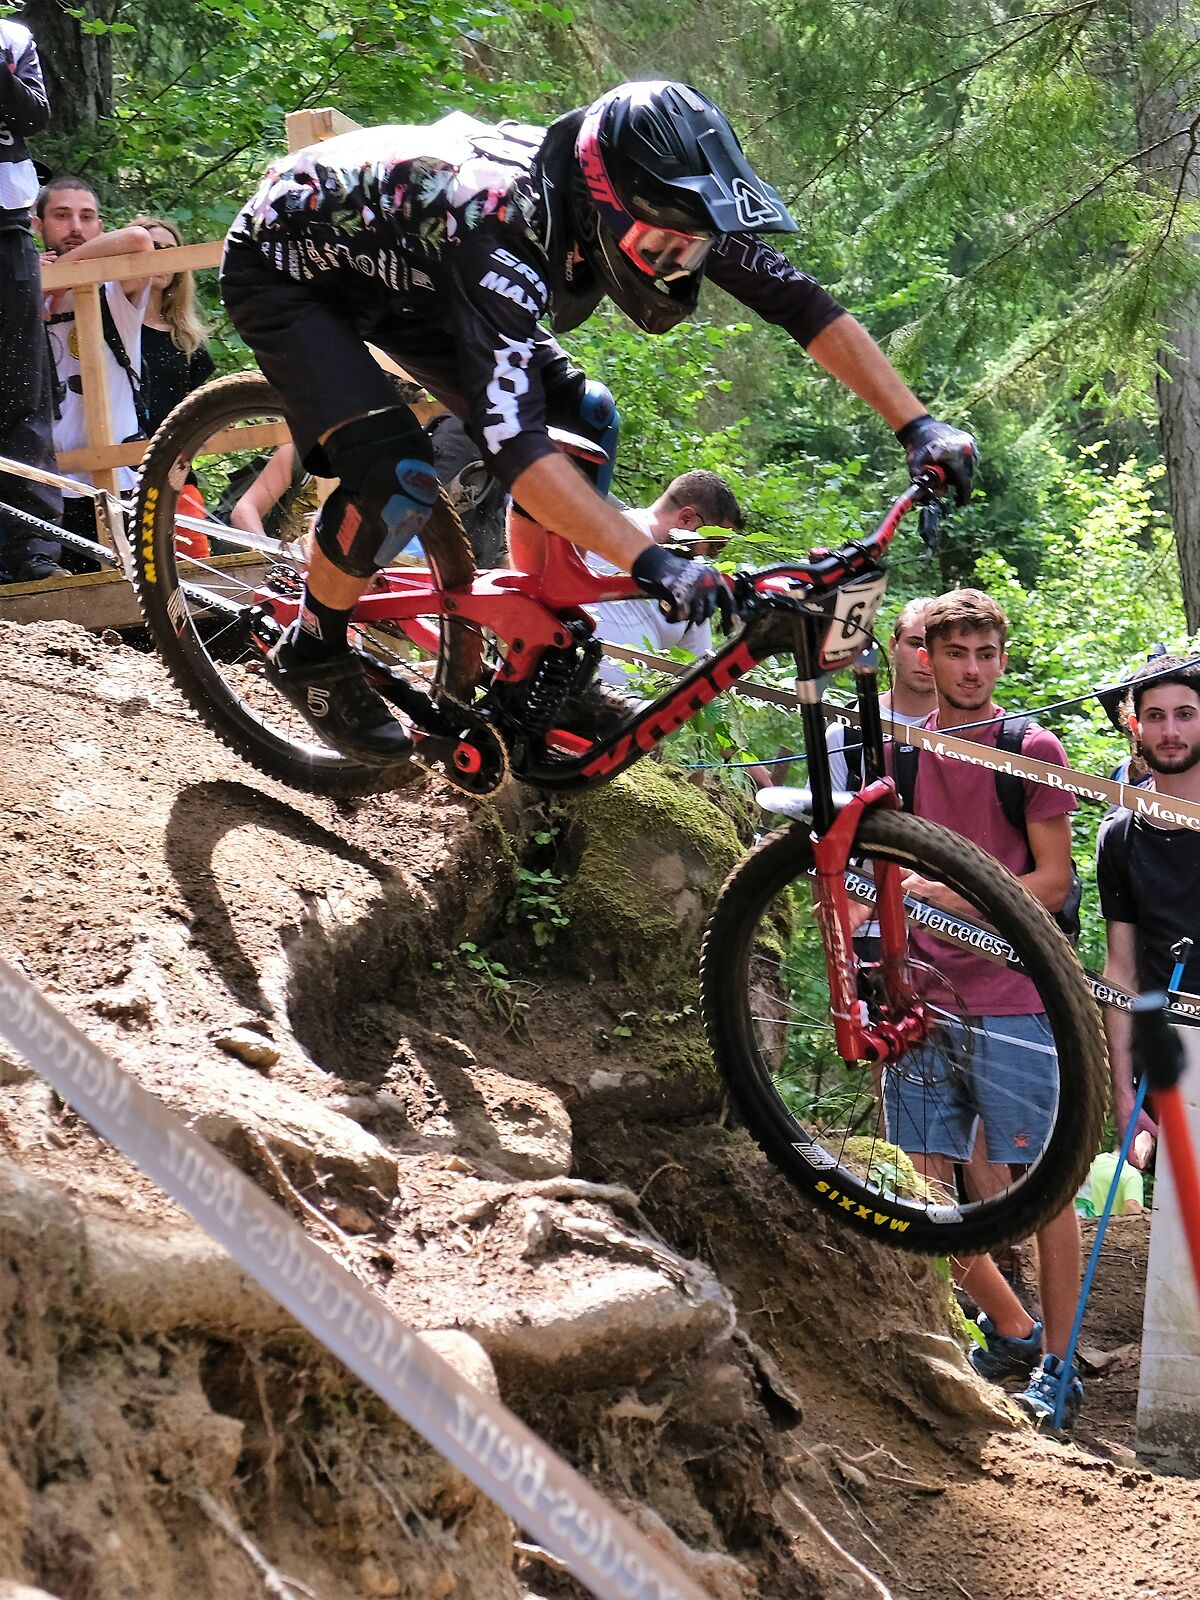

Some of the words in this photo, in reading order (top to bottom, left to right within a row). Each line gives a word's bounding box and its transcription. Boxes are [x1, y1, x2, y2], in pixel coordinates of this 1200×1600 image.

[489, 247, 548, 304] SRA
[142, 487, 160, 584] MAXXIS
[813, 1180, 911, 1234] MAXXIS
